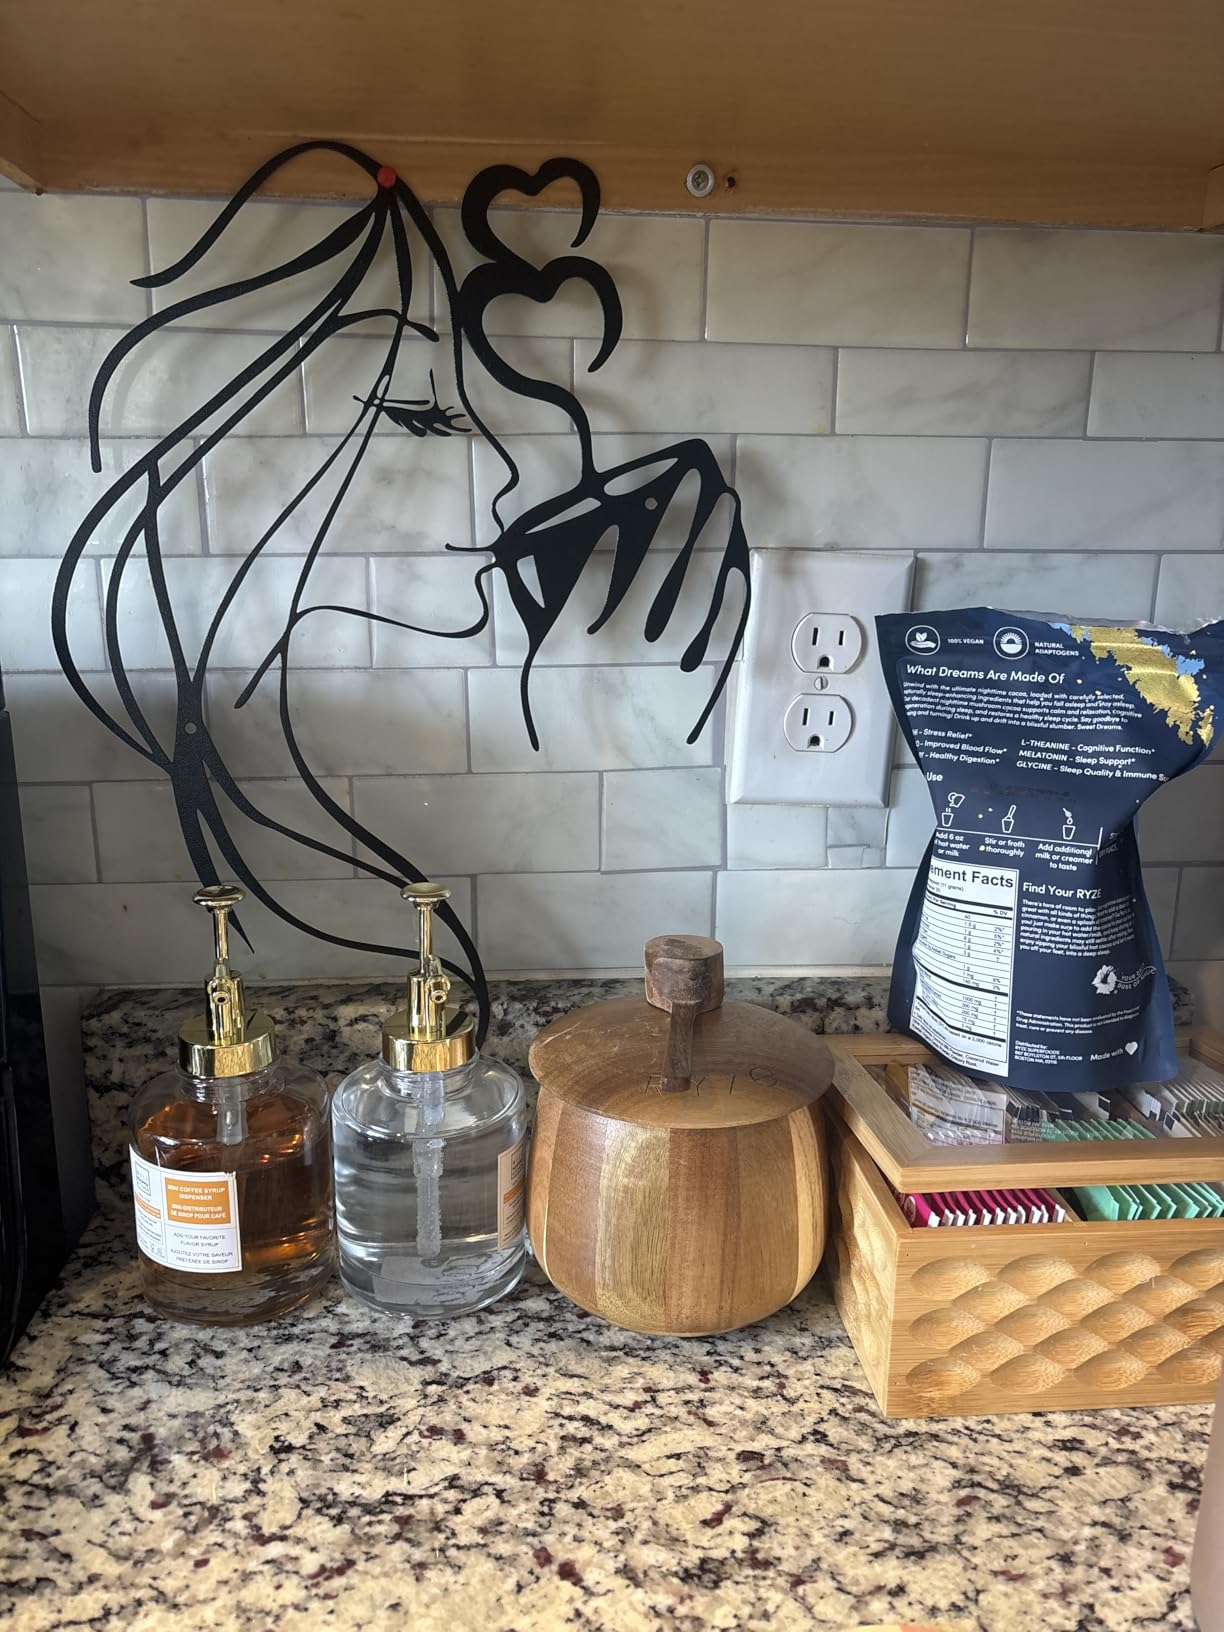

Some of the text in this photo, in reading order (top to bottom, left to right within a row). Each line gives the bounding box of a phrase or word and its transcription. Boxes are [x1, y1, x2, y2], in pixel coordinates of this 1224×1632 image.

[907, 665, 1065, 684] What Dreams Are Made Of
[927, 690, 976, 700] sleep-enhancing
[978, 695, 1011, 703] ingredients
[977, 687, 1006, 696] nighttime
[969, 701, 1001, 709] mushroom
[1112, 709, 1142, 718] cognitive
[1020, 713, 1043, 721] healthy
[925, 740, 960, 749] Improved
[961, 744, 984, 752] Blood
[1021, 739, 1070, 751] L-THEANINE
[1077, 744, 1114, 753] Cognitive
[930, 752, 958, 762] Healthy
[1019, 750, 1067, 761] MELATONIN
[1075, 756, 1097, 765] Sleep
[927, 772, 943, 781] Use
[1016, 761, 1052, 771] GLYCINE
[1059, 765, 1082, 775] Sleep
[1084, 768, 1113, 778] Quality
[1123, 771, 1157, 779] Immune
[940, 840, 951, 848] hot
[1008, 839, 1025, 848] froth
[1038, 843, 1052, 851] Add
[1054, 844, 1093, 857] additional
[946, 848, 959, 857] milk
[985, 845, 1025, 858] thoroughly
[1035, 852, 1050, 860] milk
[1061, 855, 1093, 864] creamer
[1058, 863, 1077, 871] taste
[972, 871, 1014, 888] Facts
[1023, 883, 1101, 900] Find Your RYZE
[1090, 1048, 1123, 1061] Made with
